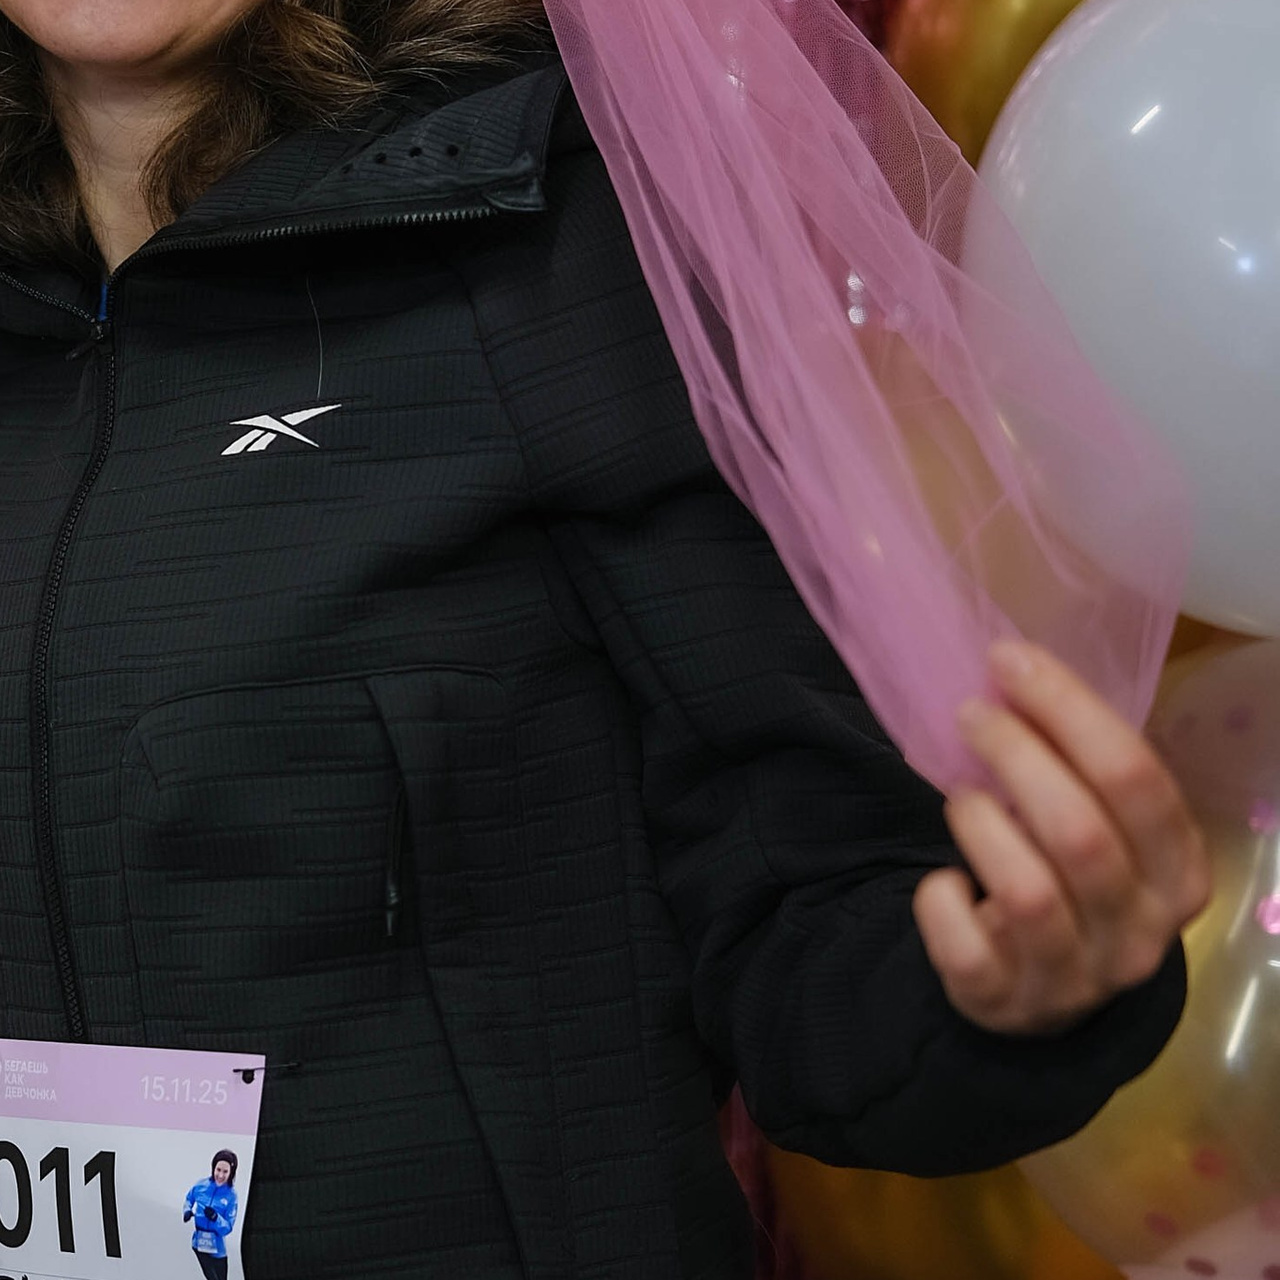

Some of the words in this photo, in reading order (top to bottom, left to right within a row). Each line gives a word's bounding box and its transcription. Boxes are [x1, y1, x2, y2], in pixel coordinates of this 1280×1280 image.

[4, 1059, 49, 1074] БЕГАЕШЬ
[4, 1073, 25, 1086] КАК
[5, 1085, 57, 1101] ДЕВЧОНКА
[140, 1075, 228, 1105] 15.11.25
